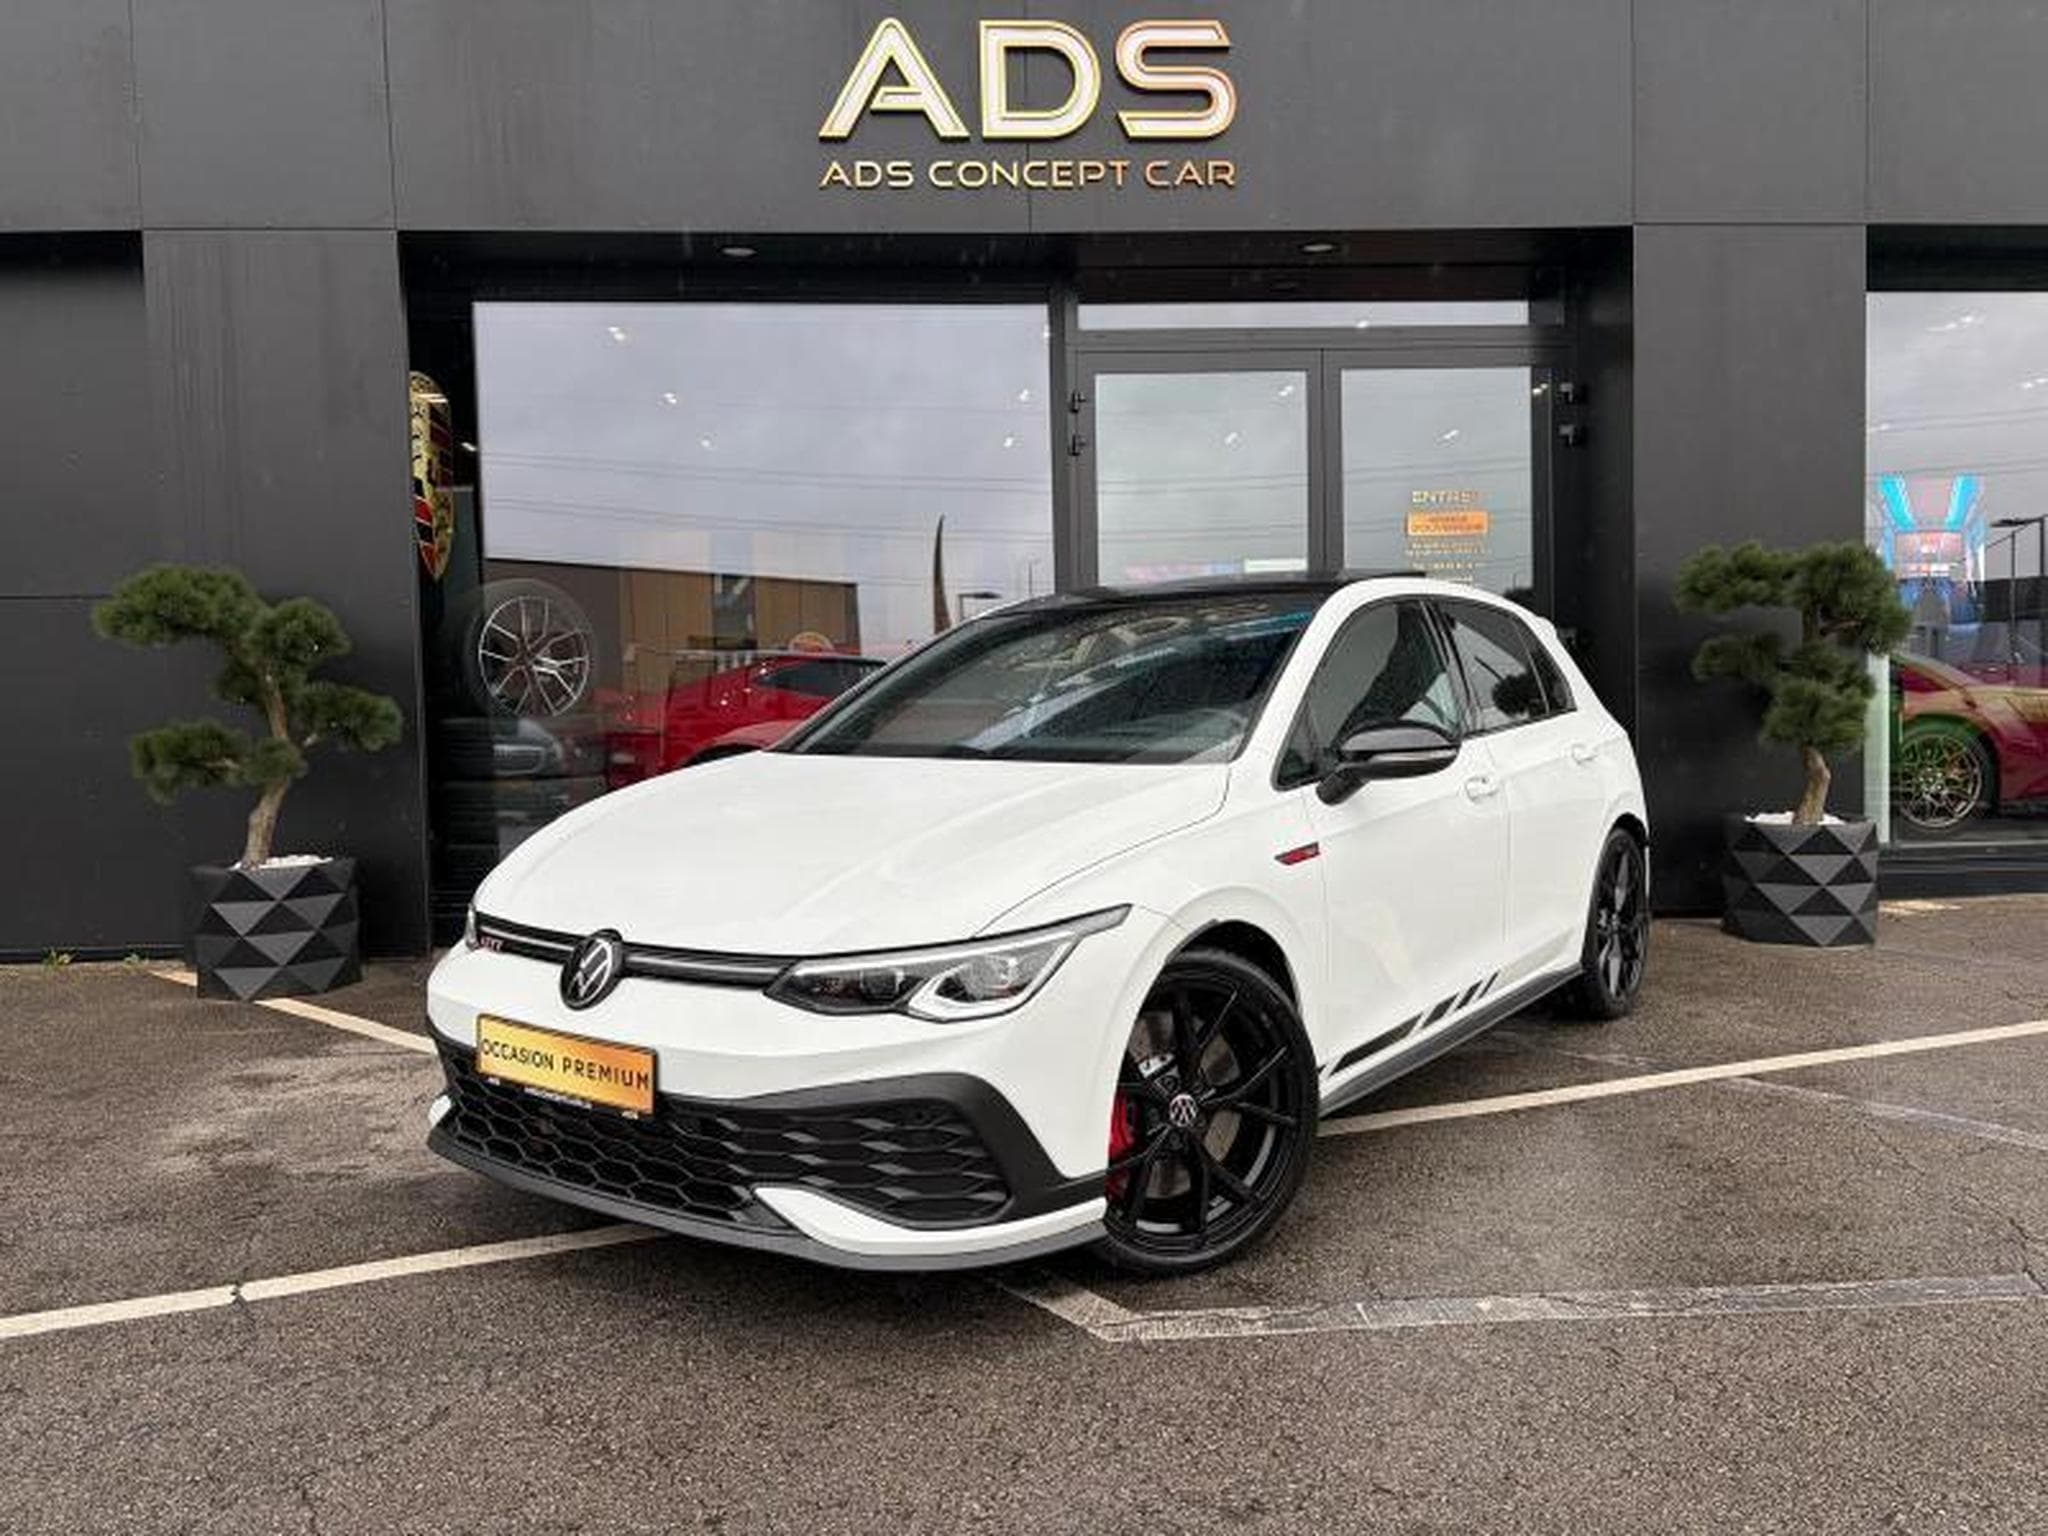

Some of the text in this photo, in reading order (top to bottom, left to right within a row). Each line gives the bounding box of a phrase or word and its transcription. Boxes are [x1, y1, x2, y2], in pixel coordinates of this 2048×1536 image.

[819, 17, 1238, 139] ADS
[819, 160, 1237, 189] ADS CONCEPT CAR
[481, 1038, 650, 1091] OCCASION PREMIUM
